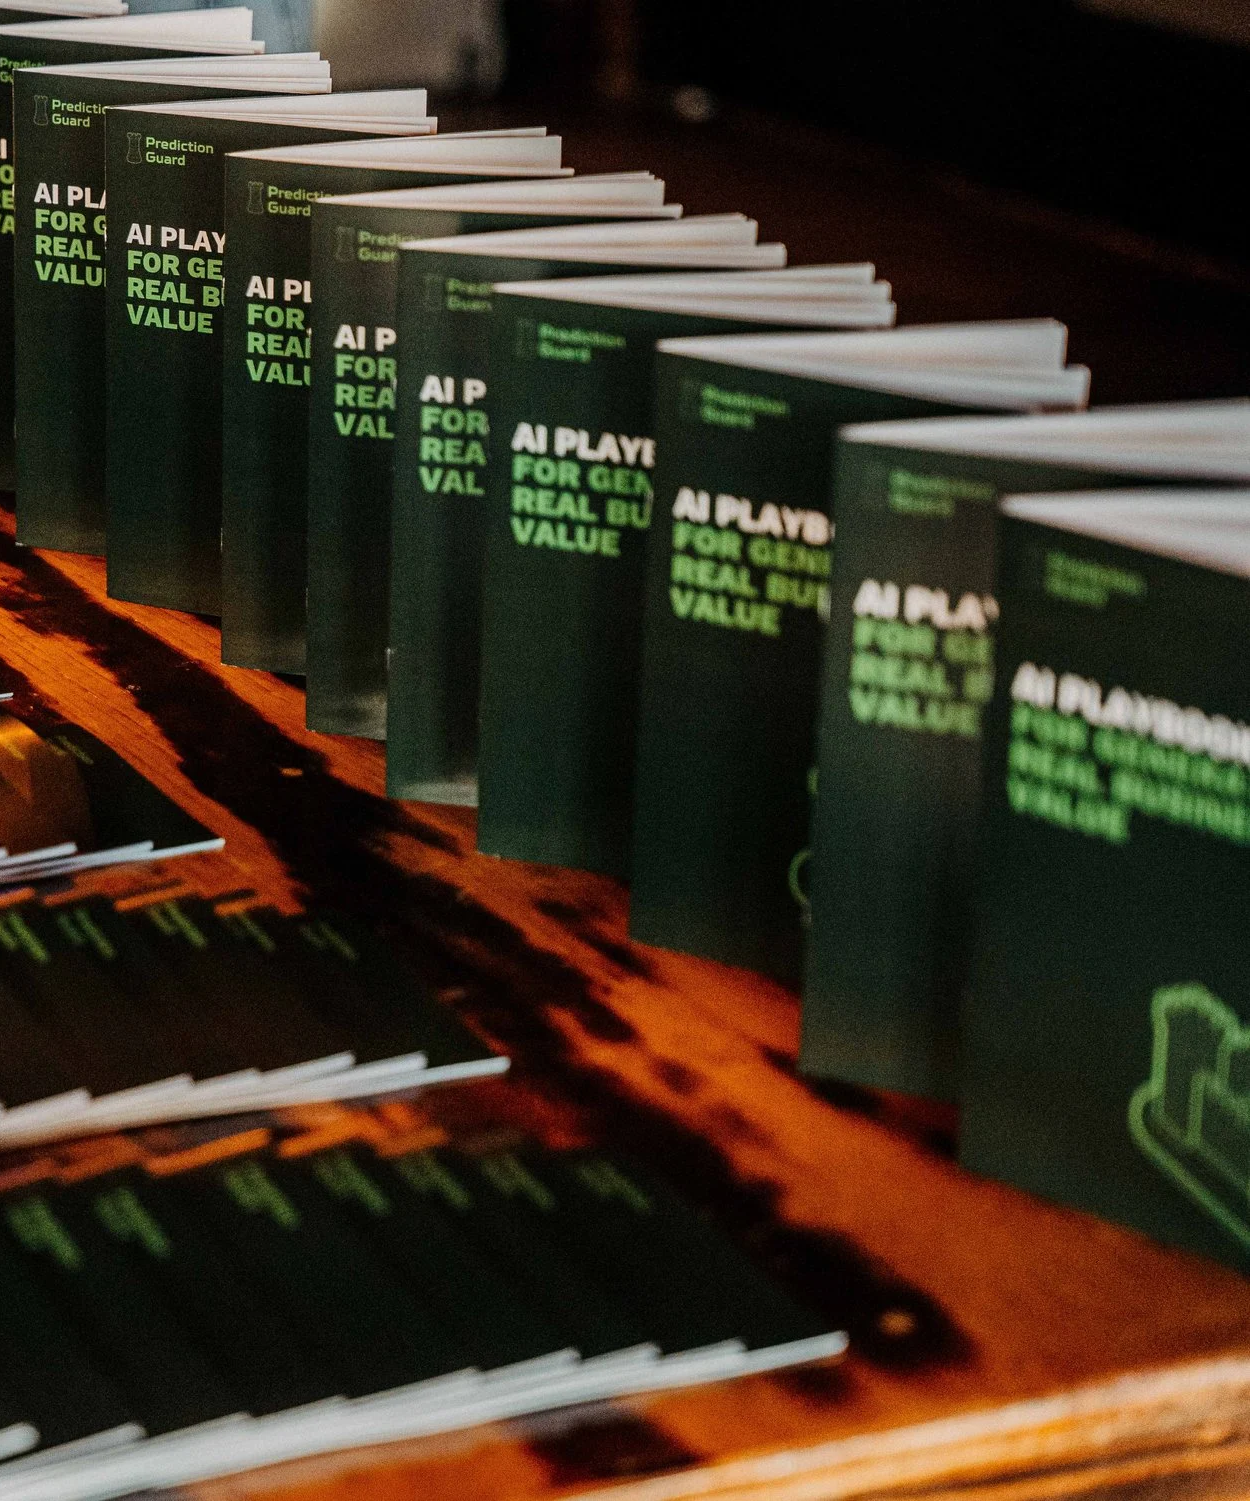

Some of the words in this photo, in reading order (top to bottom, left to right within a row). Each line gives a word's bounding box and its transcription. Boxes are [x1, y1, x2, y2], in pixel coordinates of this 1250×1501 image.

[51, 113, 90, 127] Guard
[146, 136, 214, 155] Prediction
[146, 151, 186, 166] Guard
[33, 182, 58, 204] AI
[35, 209, 86, 234] FOR
[267, 201, 312, 216] Guard
[35, 234, 101, 261] REAL
[126, 223, 152, 246] AI
[127, 250, 180, 276] FOR
[127, 277, 195, 305] REAL
[246, 275, 275, 300] AI
[126, 303, 214, 334] VALUE
[247, 303, 306, 330] FOR
[334, 324, 366, 350] AI
[335, 354, 397, 380] FOR
[419, 374, 454, 403] AI
[421, 406, 490, 436] FOR
[511, 422, 548, 454] AI
[512, 455, 581, 489] FOR
[511, 486, 599, 523] REAL
[672, 485, 711, 524] AI
[510, 516, 621, 557] VALUE
